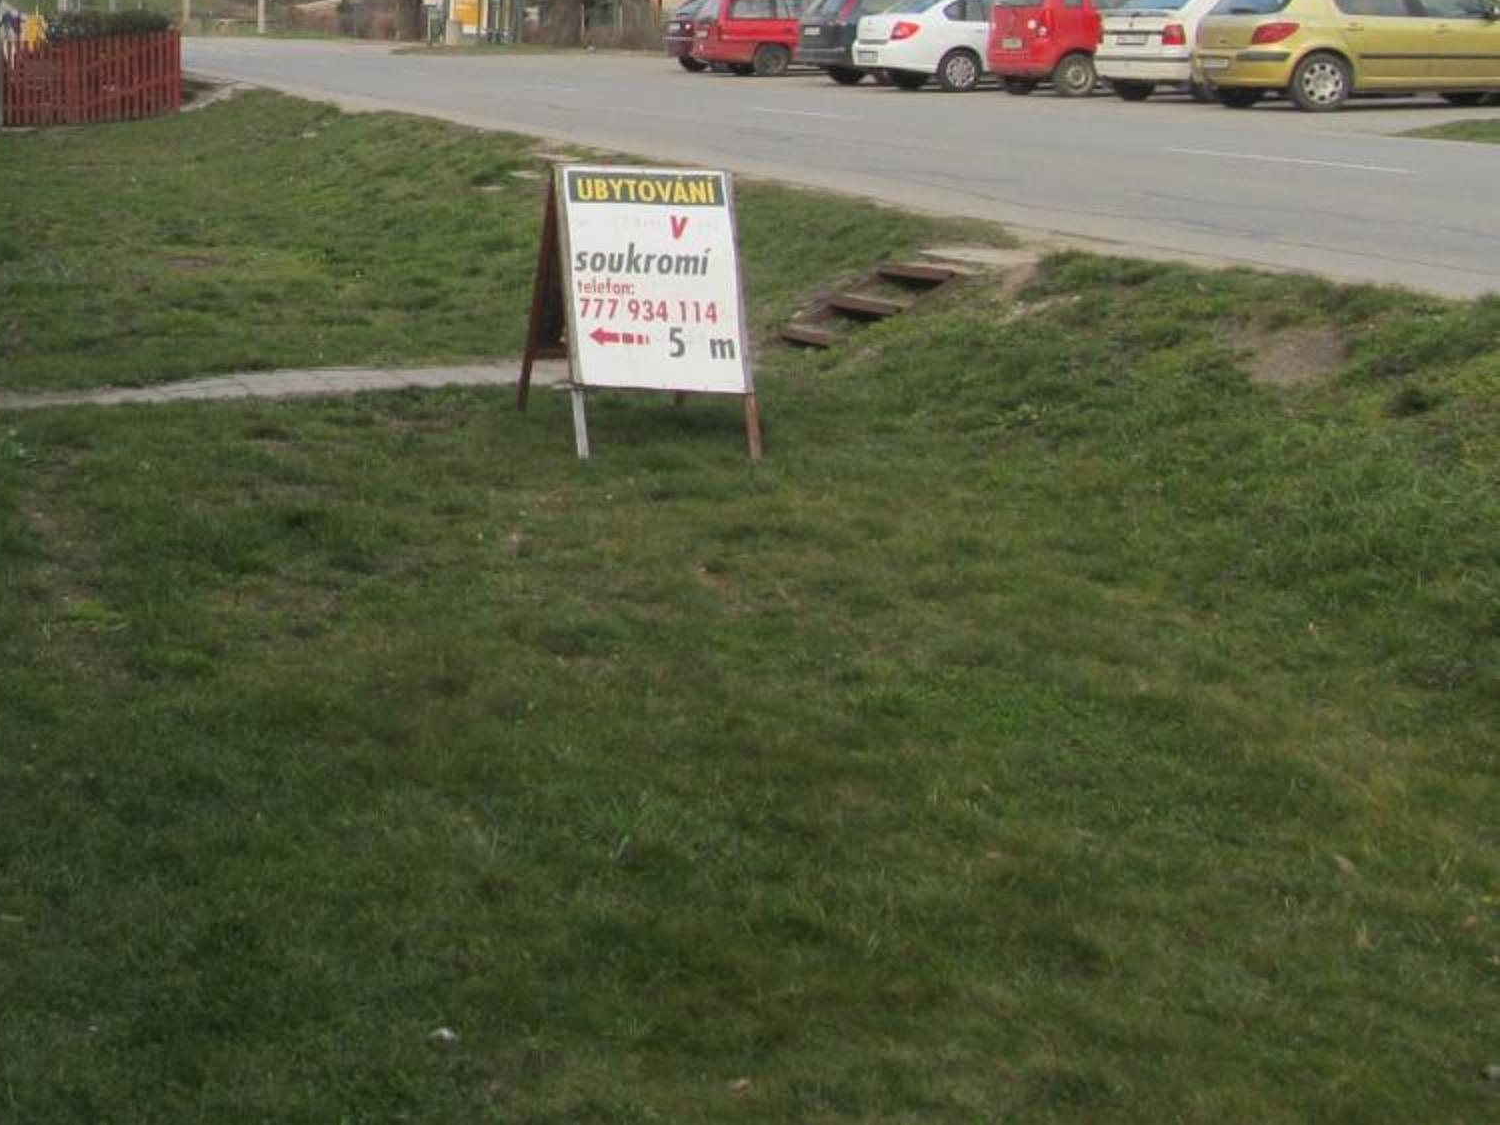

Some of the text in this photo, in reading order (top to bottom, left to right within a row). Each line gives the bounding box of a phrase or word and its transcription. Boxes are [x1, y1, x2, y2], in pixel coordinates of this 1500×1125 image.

[576, 174, 716, 204] UBYTOVÁNÍ
[573, 242, 712, 276] soukromí
[577, 279, 636, 296] telefon:
[579, 298, 719, 324] 777 934 114
[668, 327, 736, 360] 5 m
